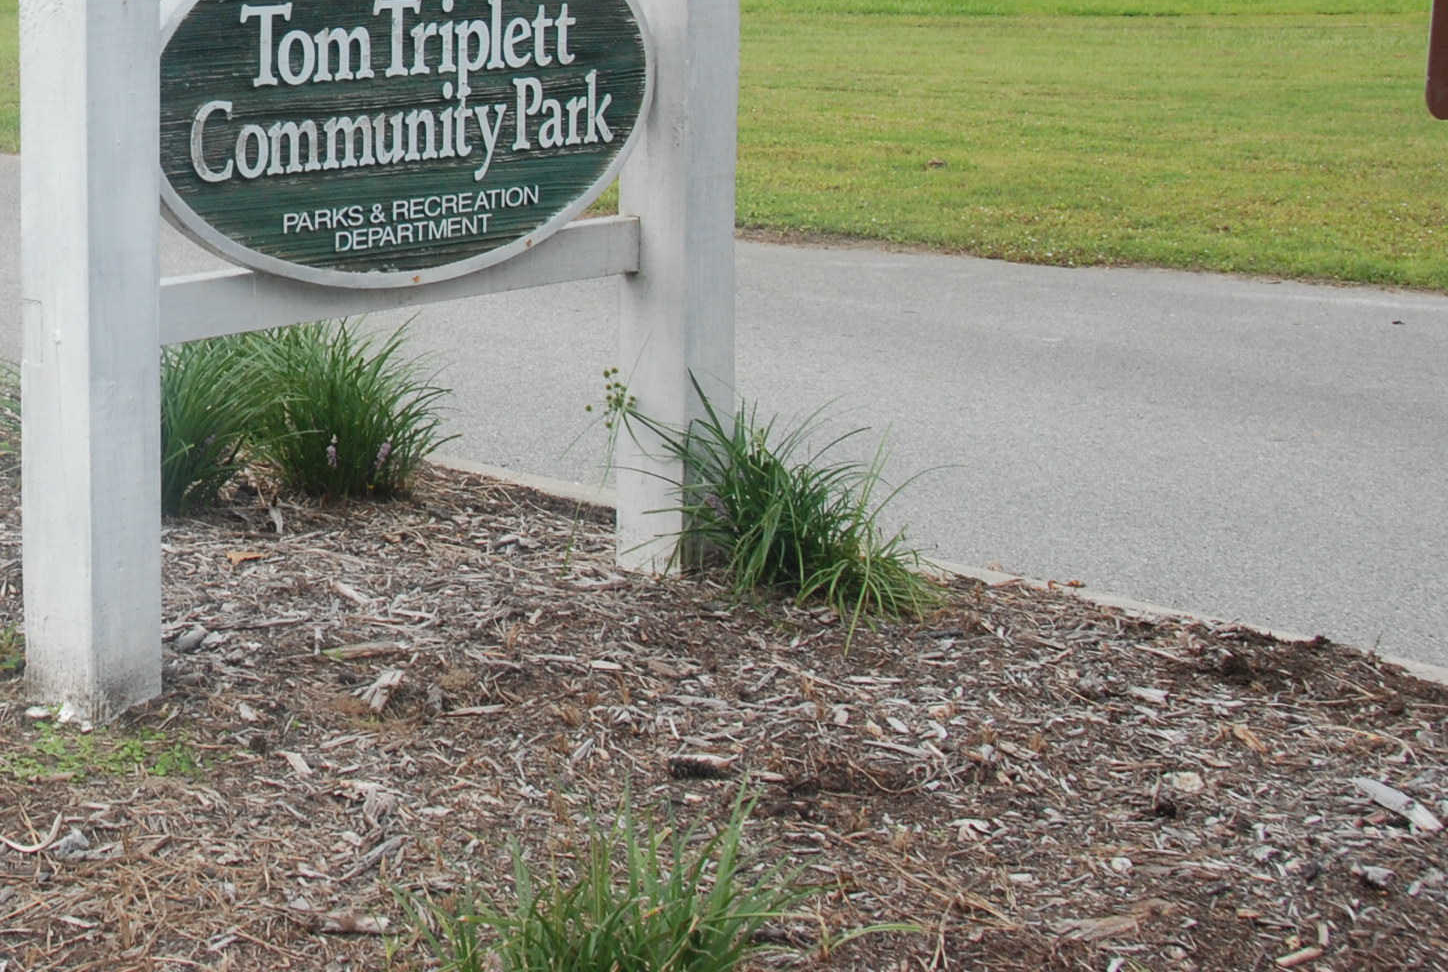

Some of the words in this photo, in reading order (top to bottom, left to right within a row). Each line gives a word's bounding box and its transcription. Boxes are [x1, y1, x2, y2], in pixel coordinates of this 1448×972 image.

[240, 2, 375, 87] Tom
[190, 81, 507, 182] Community
[511, 69, 614, 150] Park
[283, 206, 364, 235] PARKS
[371, 204, 386, 225] &
[391, 185, 539, 219] RECREATION
[335, 214, 492, 252] DEPARTMENT
